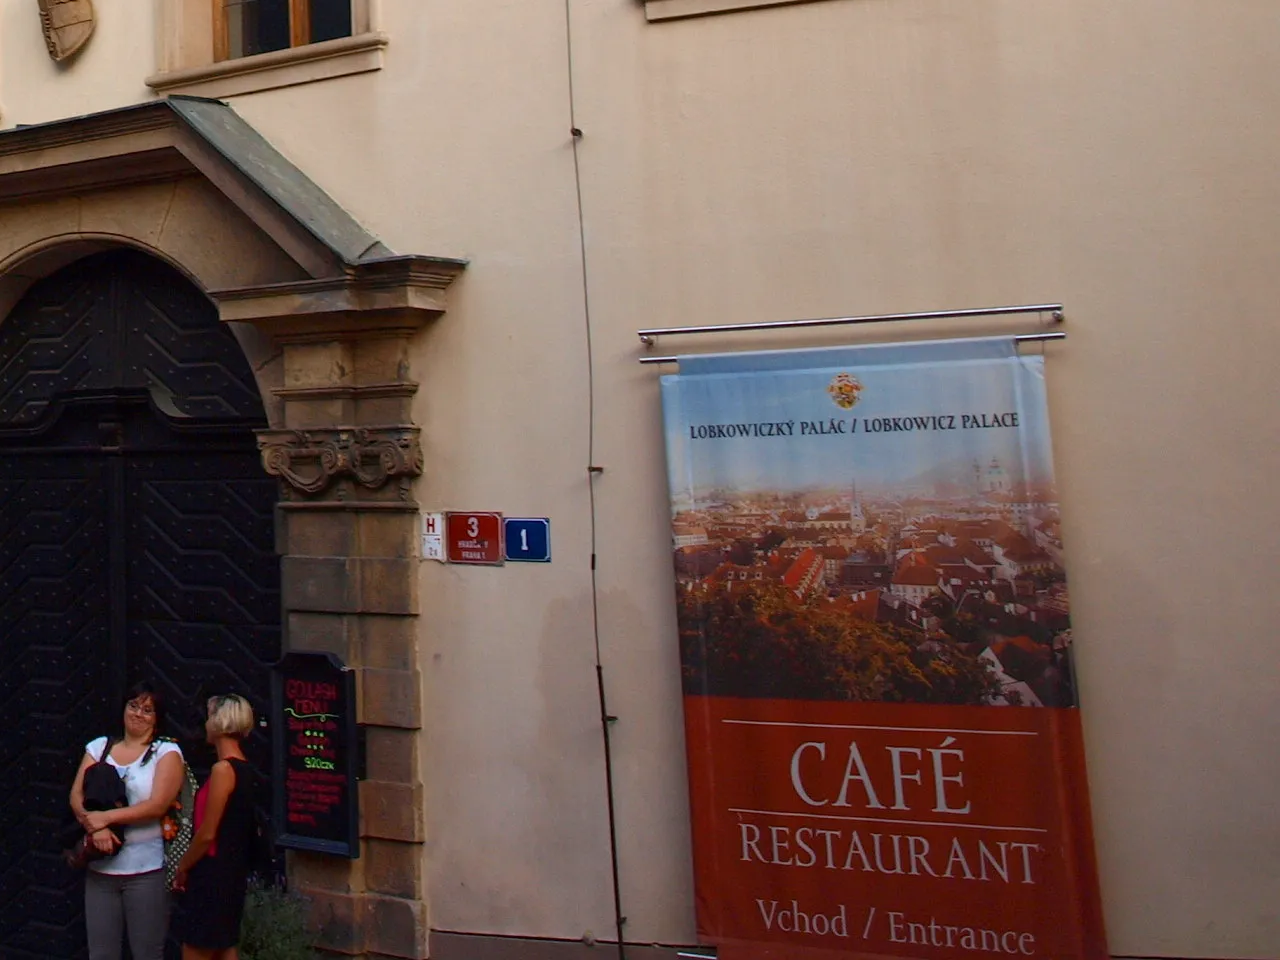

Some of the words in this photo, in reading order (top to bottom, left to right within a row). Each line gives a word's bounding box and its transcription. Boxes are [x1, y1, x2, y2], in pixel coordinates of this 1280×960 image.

[690, 419, 794, 439] LOBKOWICZKÝ
[801, 418, 847, 435] PALÁC
[851, 418, 858, 434] /
[864, 413, 956, 433] LOBKOWICZ
[961, 411, 1020, 429] PALACE
[426, 517, 435, 533] H
[467, 516, 479, 538] 3
[520, 528, 529, 551] 1
[791, 736, 971, 815] CAFÉ
[738, 823, 1041, 884] RESTAURANT
[755, 898, 848, 938] Vchod
[863, 906, 876, 939] /
[887, 911, 1035, 956] Entrance
